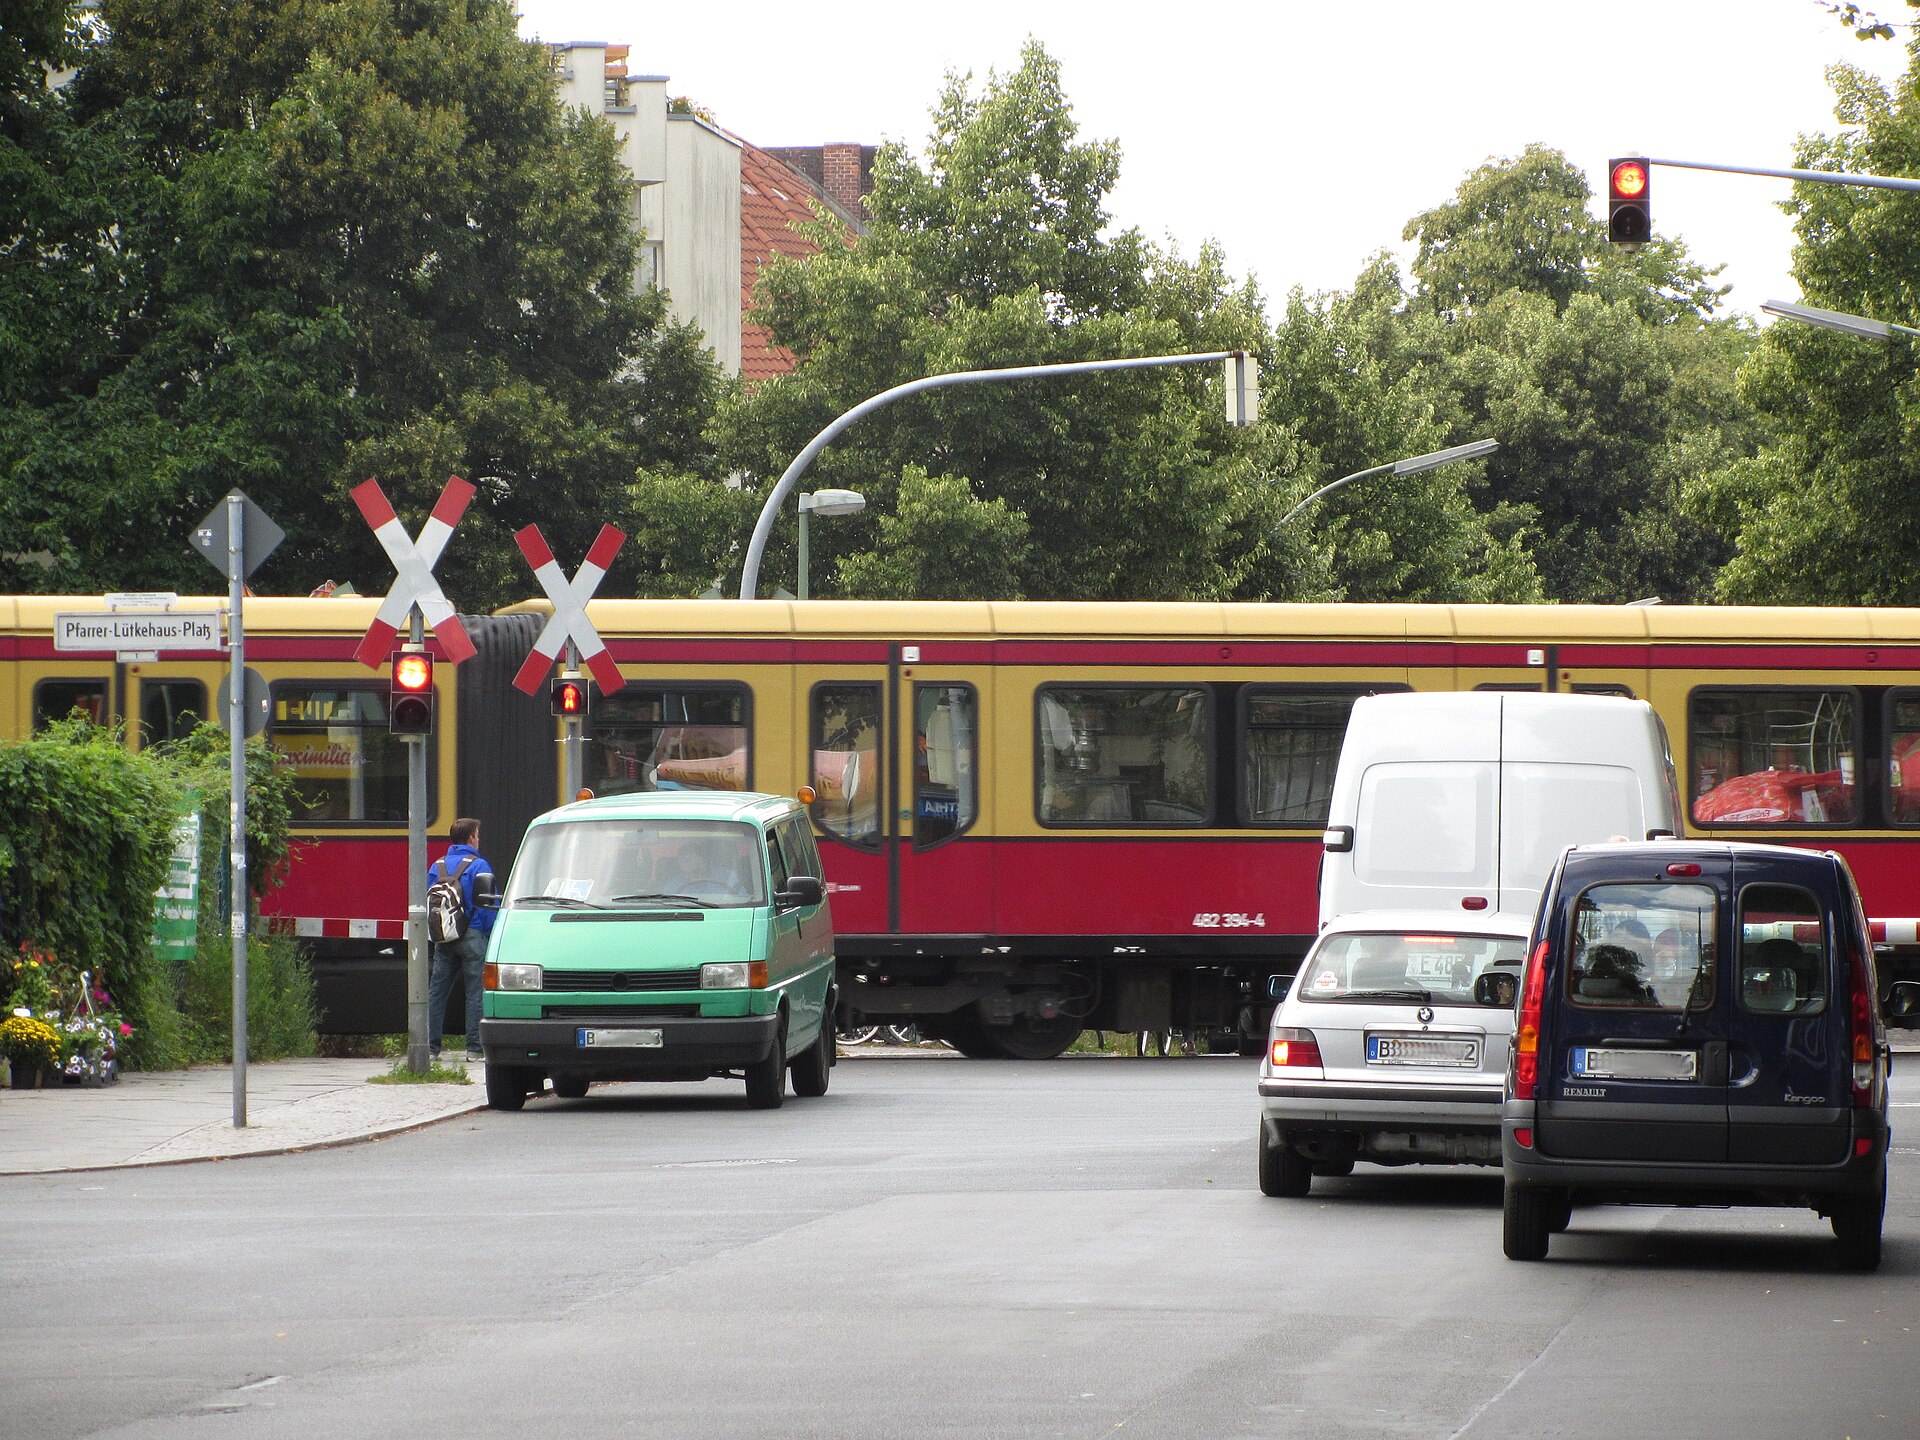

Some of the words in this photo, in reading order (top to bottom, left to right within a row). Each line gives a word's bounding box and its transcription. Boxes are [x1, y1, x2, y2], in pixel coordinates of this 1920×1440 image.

[66, 621, 211, 640] Pfarrer-Lütkehaus-Platz
[1192, 913, 1220, 927] 482
[1222, 913, 1266, 927] 394-4
[1563, 1087, 1607, 1097] RENAULT
[1784, 1087, 1826, 1104] Kangoo
